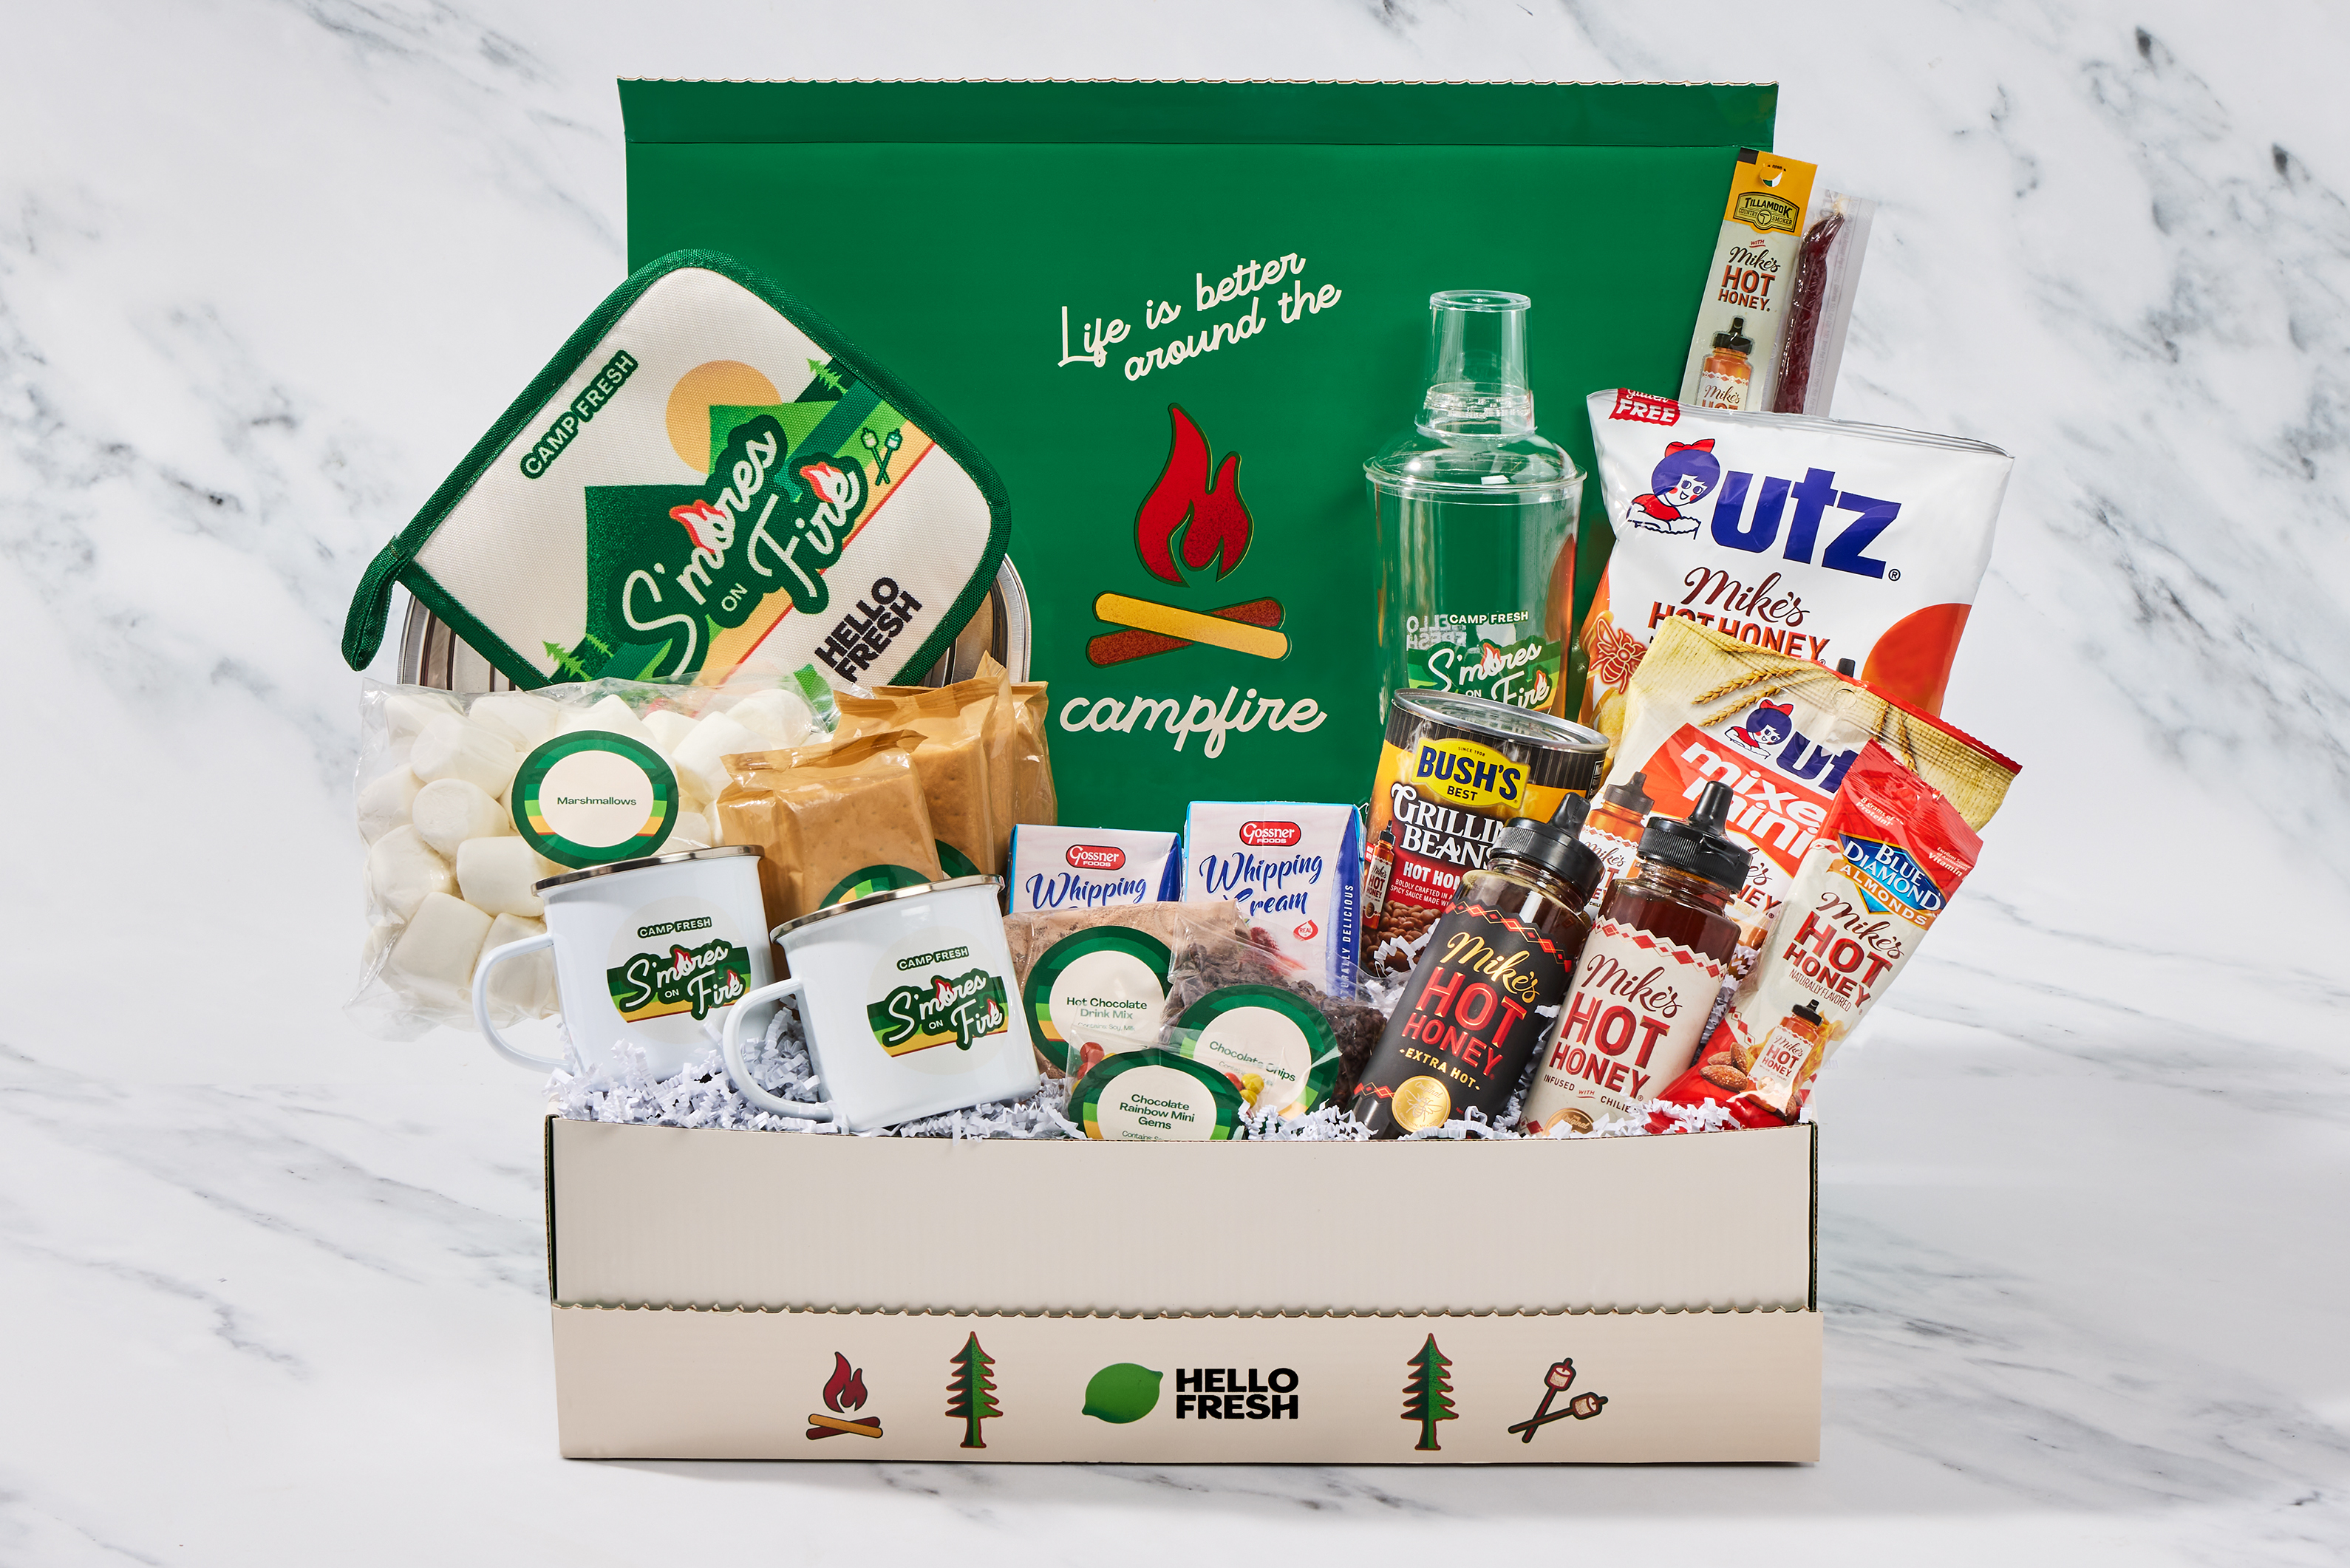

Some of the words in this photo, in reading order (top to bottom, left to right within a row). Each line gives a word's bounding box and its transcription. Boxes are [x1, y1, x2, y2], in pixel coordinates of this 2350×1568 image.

[1738, 208, 1757, 217] COUNTRY
[1771, 216, 1792, 225] SMOKER
[1745, 197, 1792, 219] TILLAMOOK
[1729, 246, 1781, 273] Mike's
[1722, 265, 1776, 296] HOT
[1058, 305, 1131, 367] Life
[1145, 299, 1181, 330] is
[1196, 252, 1306, 311] better
[1124, 296, 1266, 381] around
[1277, 279, 1342, 325] the
[1704, 384, 1740, 404] Mike's
[523, 415, 579, 475] CAMP
[576, 355, 636, 421] FRESH
[1615, 398, 1676, 423] FREE
[747, 466, 862, 597] Fire
[720, 582, 749, 612] ON
[1682, 566, 1811, 627] Mike's
[814, 576, 899, 669] HELLO
[1449, 614, 1487, 624] CAMP
[1491, 610, 1529, 624] FRESH
[834, 590, 923, 684] FRESH
[1717, 616, 1830, 661] HONEY
[1428, 642, 1542, 692] S'mores
[1465, 689, 1482, 698] ON
[1491, 669, 1550, 709] Fire
[1059, 685, 1328, 759] campfire
[1457, 746, 1474, 754] SINCE
[1417, 746, 1522, 801] BUSH'S
[556, 796, 637, 806] Marshmallows
[1446, 785, 1478, 802] BEST
[1865, 802, 1886, 817] grams
[1241, 822, 1295, 842] Gossner
[1067, 846, 1120, 865] Gossner
[1875, 842, 1926, 887] BLUE
[1928, 851, 1963, 877] Vitamin
[1199, 851, 1323, 894] Whipping
[1368, 873, 1386, 891] HOT
[1403, 861, 1431, 883] HOT
[1842, 840, 1941, 913] DIAMOND
[1025, 871, 1147, 910] Whipping
[1366, 886, 1383, 899] HONEY
[1390, 886, 1406, 896] SPICY
[1405, 890, 1422, 900] SAUCE
[1423, 894, 1440, 905] MADE
[1395, 878, 1414, 892] BOLDLY
[1414, 884, 1440, 898] CRAFTED
[1441, 892, 1448, 900] IN
[1840, 865, 1927, 925] ALMONDS
[639, 924, 673, 937] CAMP
[677, 918, 712, 931] FRESH
[1342, 884, 1354, 944] DELICIOUS
[1815, 891, 1905, 959] Mike's
[1298, 927, 1312, 935] REAL
[899, 955, 933, 970] CAMP
[935, 947, 969, 961] FRESH
[1794, 911, 1894, 989] HOT
[625, 945, 729, 1008] S'mores
[1440, 931, 1541, 1003] Mike's
[1782, 942, 1872, 1008] HONEY
[664, 989, 680, 998] ON
[687, 969, 743, 1015] Fire
[1581, 953, 1683, 1019] Mike's
[1789, 968, 1822, 996] NATURALLY
[1821, 987, 1852, 1012] FLAVORED
[888, 975, 987, 1042] S'mores
[1066, 997, 1086, 1006] Hot
[1090, 998, 1148, 1009] Chocolate
[1080, 1007, 1110, 1018] Drink
[1112, 1009, 1134, 1019] Mix
[1414, 966, 1528, 1049] HOT
[928, 1019, 944, 1030] ON
[950, 998, 1003, 1045] Fire
[1560, 990, 1672, 1070] HOT
[1401, 1012, 1504, 1077] HONEY
[1766, 1043, 1800, 1069] HOT
[1774, 1035, 1803, 1057] Mike's
[1209, 1040, 1264, 1070] Chocolate
[1264, 1062, 1297, 1083] Chips
[1405, 1047, 1448, 1074] EXTRA
[1450, 1068, 1477, 1089] HOT
[1548, 1040, 1651, 1100] HONEY
[1761, 1056, 1793, 1077] HONEY
[1543, 1074, 1576, 1091] INFUSED
[1118, 1102, 1170, 1119] Rainbow
[1170, 1110, 1196, 1123] Mini
[1130, 1093, 1191, 1111] Chocolate
[1137, 1116, 1172, 1130] Gems
[1176, 1367, 1299, 1394] HELLO
[1176, 1394, 1299, 1420] FRESH
